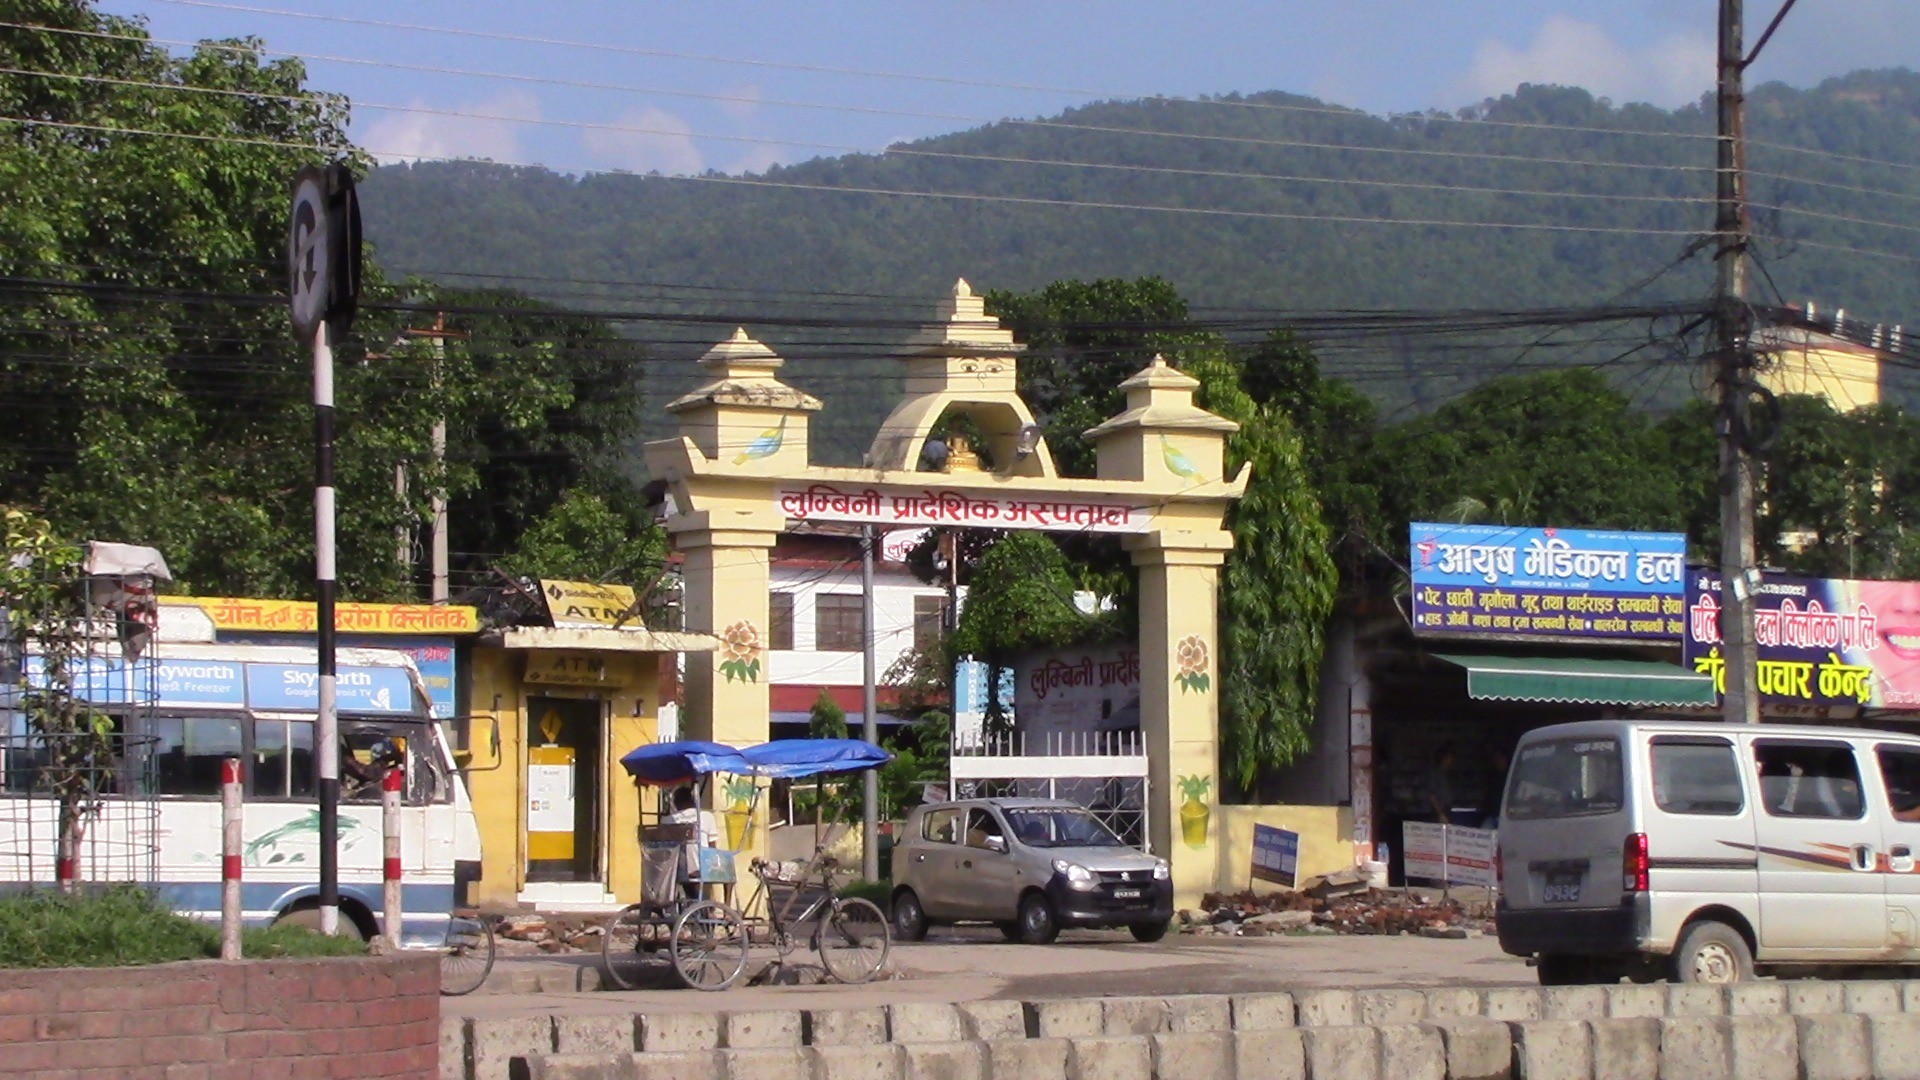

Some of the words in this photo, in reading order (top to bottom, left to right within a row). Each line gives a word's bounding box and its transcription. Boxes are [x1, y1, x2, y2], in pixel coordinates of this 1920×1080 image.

[781, 485, 883, 518] लुम्बिनी
[890, 490, 998, 521] प्रादेशिक
[1003, 500, 1132, 526] अस्पताल
[1437, 543, 1516, 584] आयुष
[1523, 538, 1629, 582] मेडिकल
[1635, 551, 1684, 583] हल
[213, 601, 262, 625] यौन
[388, 604, 469, 632] क्लिनिक
[565, 605, 628, 620] ATM
[1542, 595, 1564, 611] तथा
[1662, 595, 1683, 615] सेवा
[1781, 598, 1841, 648] क्लिनिक
[283, 670, 372, 688] Skyorth
[1030, 655, 1094, 699] लुम्बिनी
[1819, 652, 1873, 704] केन्द्र
